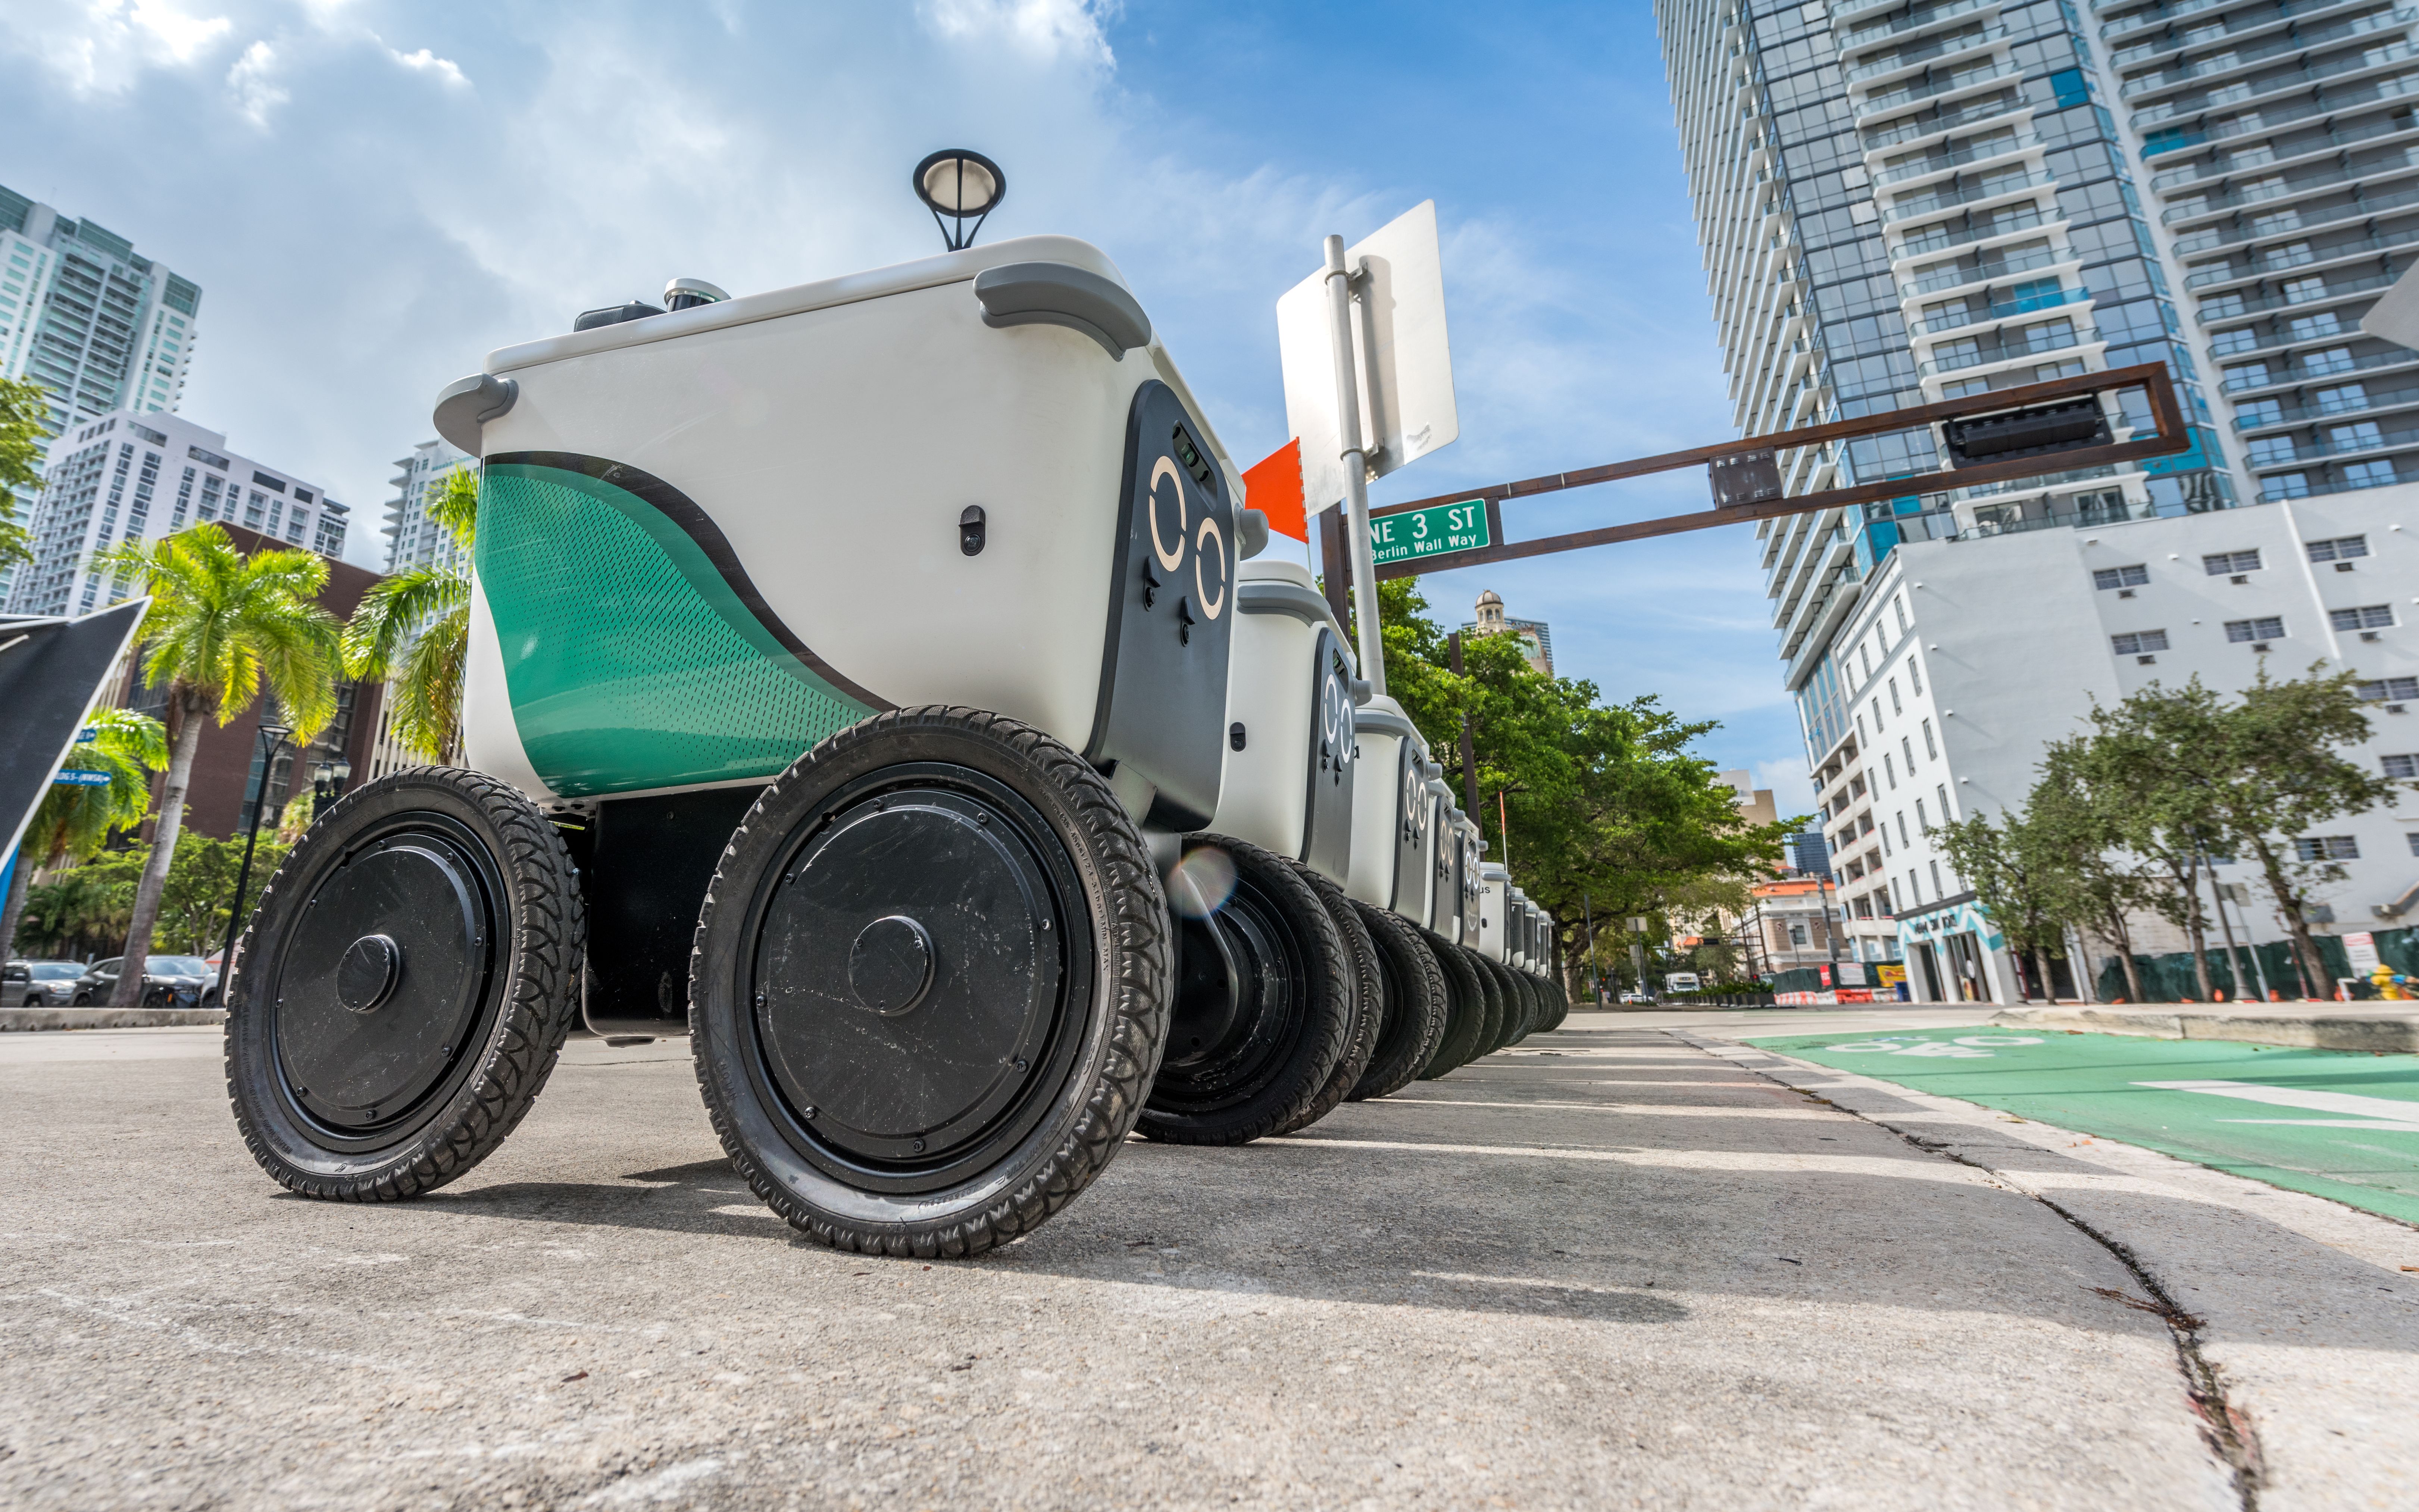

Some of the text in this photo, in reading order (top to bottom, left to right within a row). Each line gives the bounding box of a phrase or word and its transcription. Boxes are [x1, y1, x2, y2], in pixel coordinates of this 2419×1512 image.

[1371, 506, 1475, 544] NE 3 ST
[1371, 534, 1476, 560] Berlin Wall Way
[720, 1063, 738, 1100] NYLON
